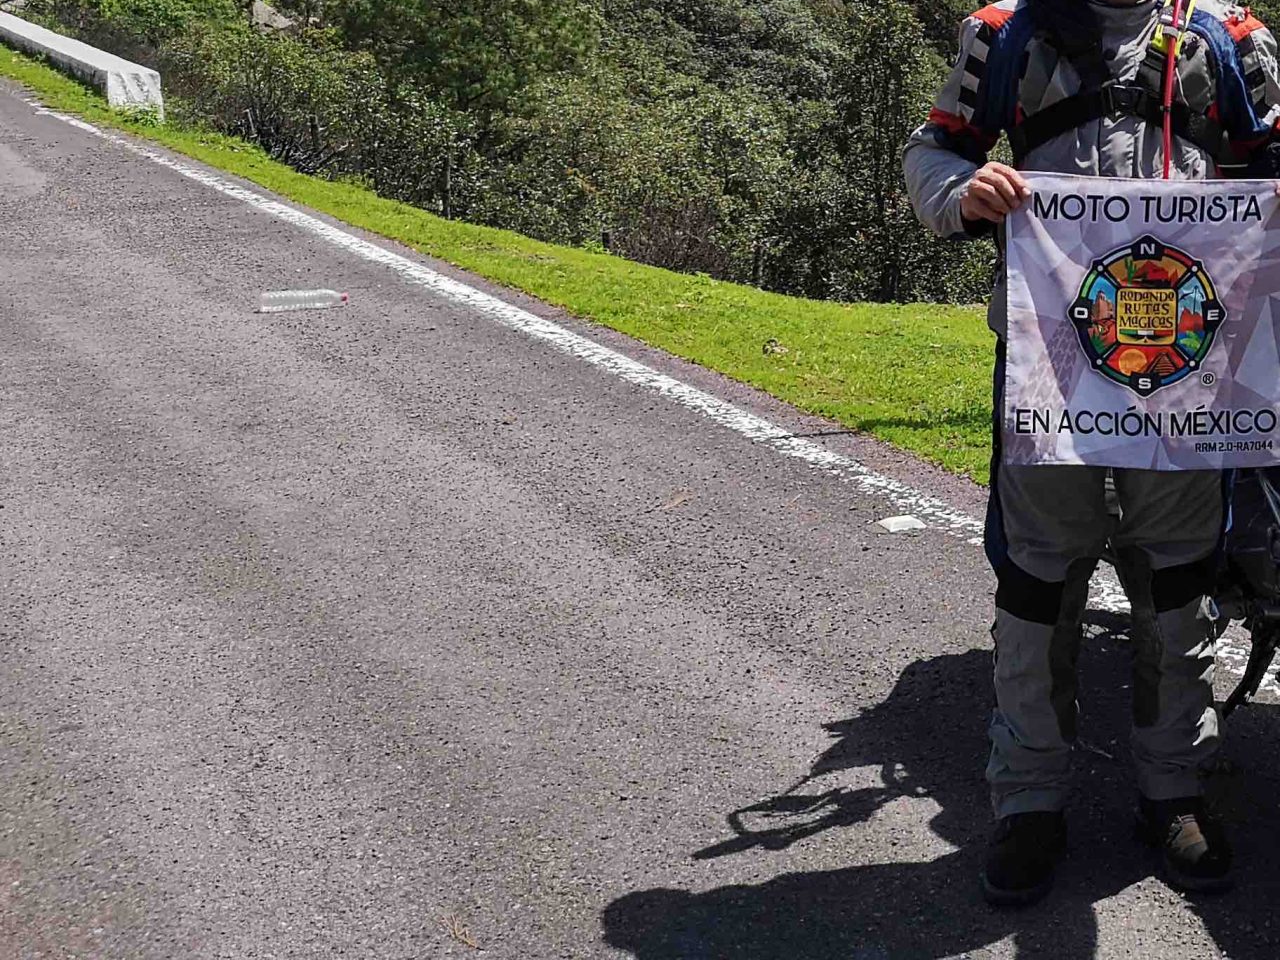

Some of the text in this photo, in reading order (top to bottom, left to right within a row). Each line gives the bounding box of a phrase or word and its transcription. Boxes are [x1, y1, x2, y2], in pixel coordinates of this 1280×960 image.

[1032, 191, 1263, 223] MOTO TURISTA
[1140, 243, 1156, 255] N
[1074, 307, 1089, 319] O
[1207, 309, 1220, 320] E
[1138, 378, 1152, 389] S
[1014, 404, 1277, 437] EN ACCIÓN MÉXICO
[1194, 442, 1217, 453] RRM
